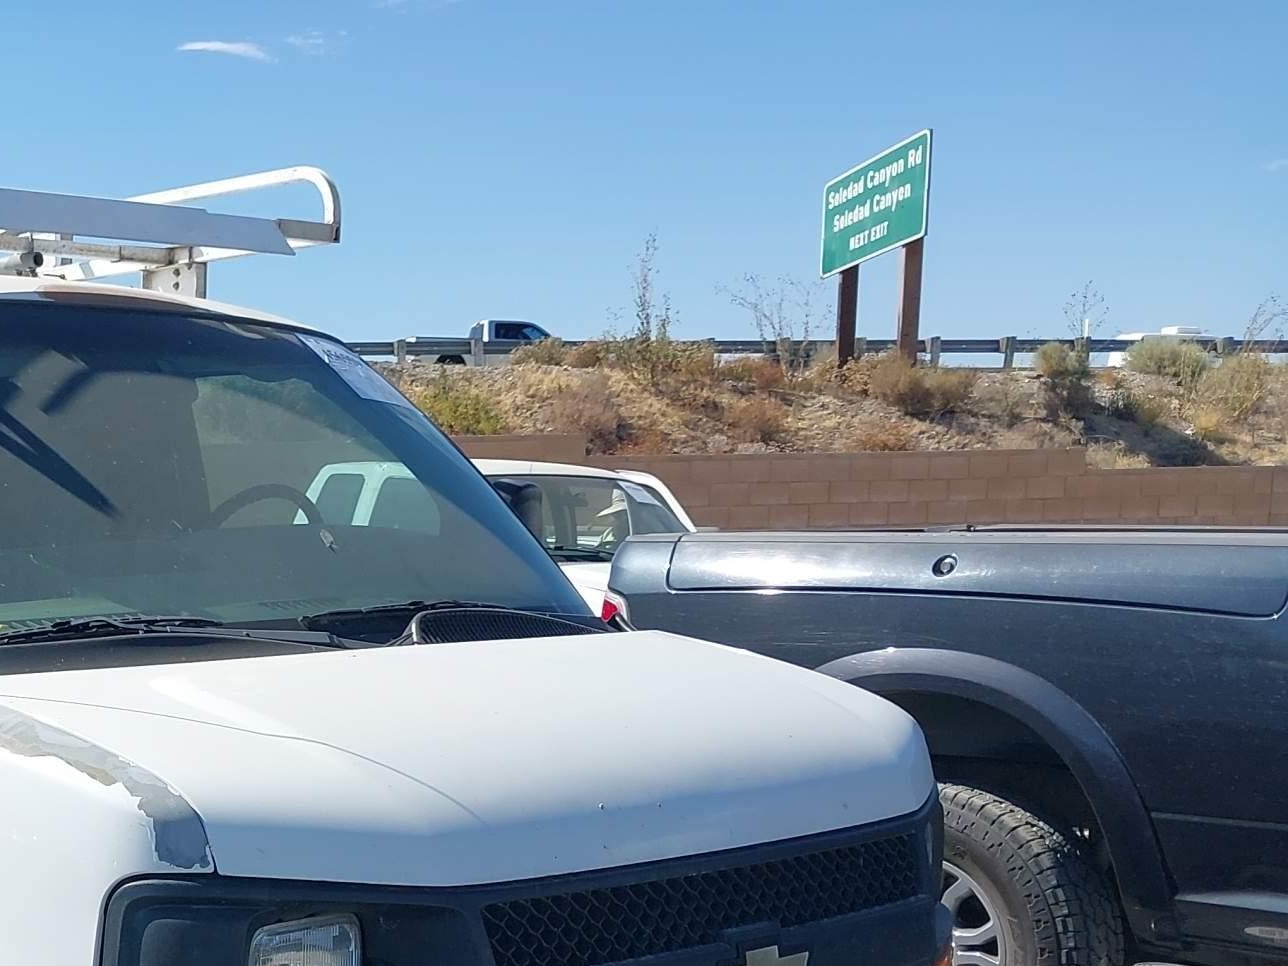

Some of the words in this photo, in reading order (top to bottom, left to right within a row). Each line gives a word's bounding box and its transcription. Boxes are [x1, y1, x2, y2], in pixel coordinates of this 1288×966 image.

[828, 175, 864, 210] Soledad
[867, 158, 904, 188] Canyon
[907, 144, 922, 168] Rd
[833, 199, 870, 233] Soledad
[873, 183, 911, 212] Canyon
[870, 221, 888, 241] EXIT
